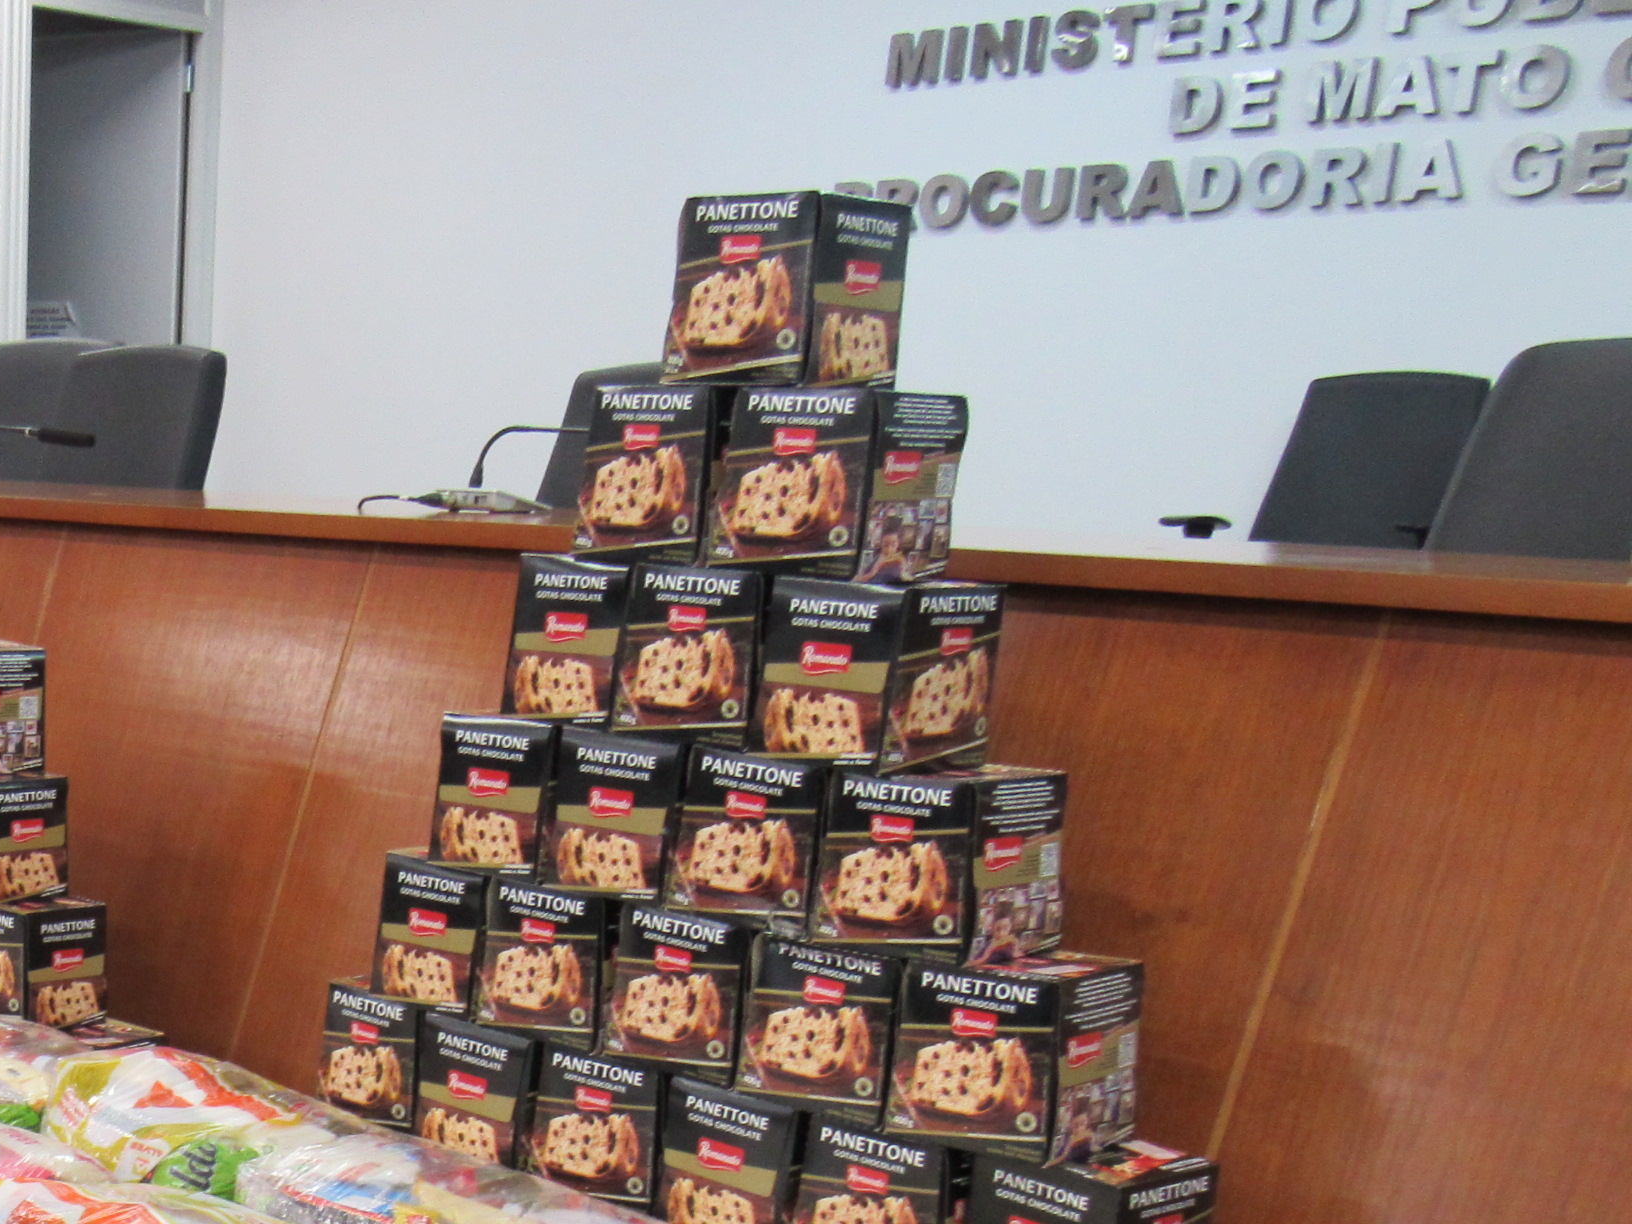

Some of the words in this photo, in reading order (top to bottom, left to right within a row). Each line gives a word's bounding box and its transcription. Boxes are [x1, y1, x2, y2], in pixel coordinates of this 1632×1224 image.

[1169, 68, 1282, 140] DE
[1307, 43, 1574, 127] MATO
[696, 201, 799, 222] PANETTONE
[837, 213, 899, 237] PANETTONE
[601, 394, 693, 410] PANETTONE
[748, 395, 856, 414] PANETTONE
[534, 573, 608, 590] PANETTONE
[644, 573, 741, 595] PANETTONE
[790, 599, 879, 619] PANETTONE
[919, 595, 998, 613] PANETTONE
[455, 730, 529, 750] PANETTONE
[577, 747, 656, 769] PANETTONE
[701, 756, 804, 787] PANETTONE
[843, 780, 953, 807] PANETTONE
[397, 871, 465, 895] PANETTONE
[499, 886, 585, 916] PANETTONE
[41, 919, 95, 934] PANETTONE
[632, 911, 726, 945] PANETTONE
[778, 942, 882, 976] PANETTONE
[921, 971, 1038, 1004] PANETTONE
[333, 991, 404, 1021] PANETTONE
[437, 1032, 509, 1062] PANETTONE
[552, 1053, 644, 1086] PANETTONE
[685, 1096, 769, 1130] PANETTONE
[820, 1127, 926, 1167] PANETTONE
[993, 1170, 1090, 1211] PANETTONE
[1128, 1176, 1211, 1209] PANETTONE
